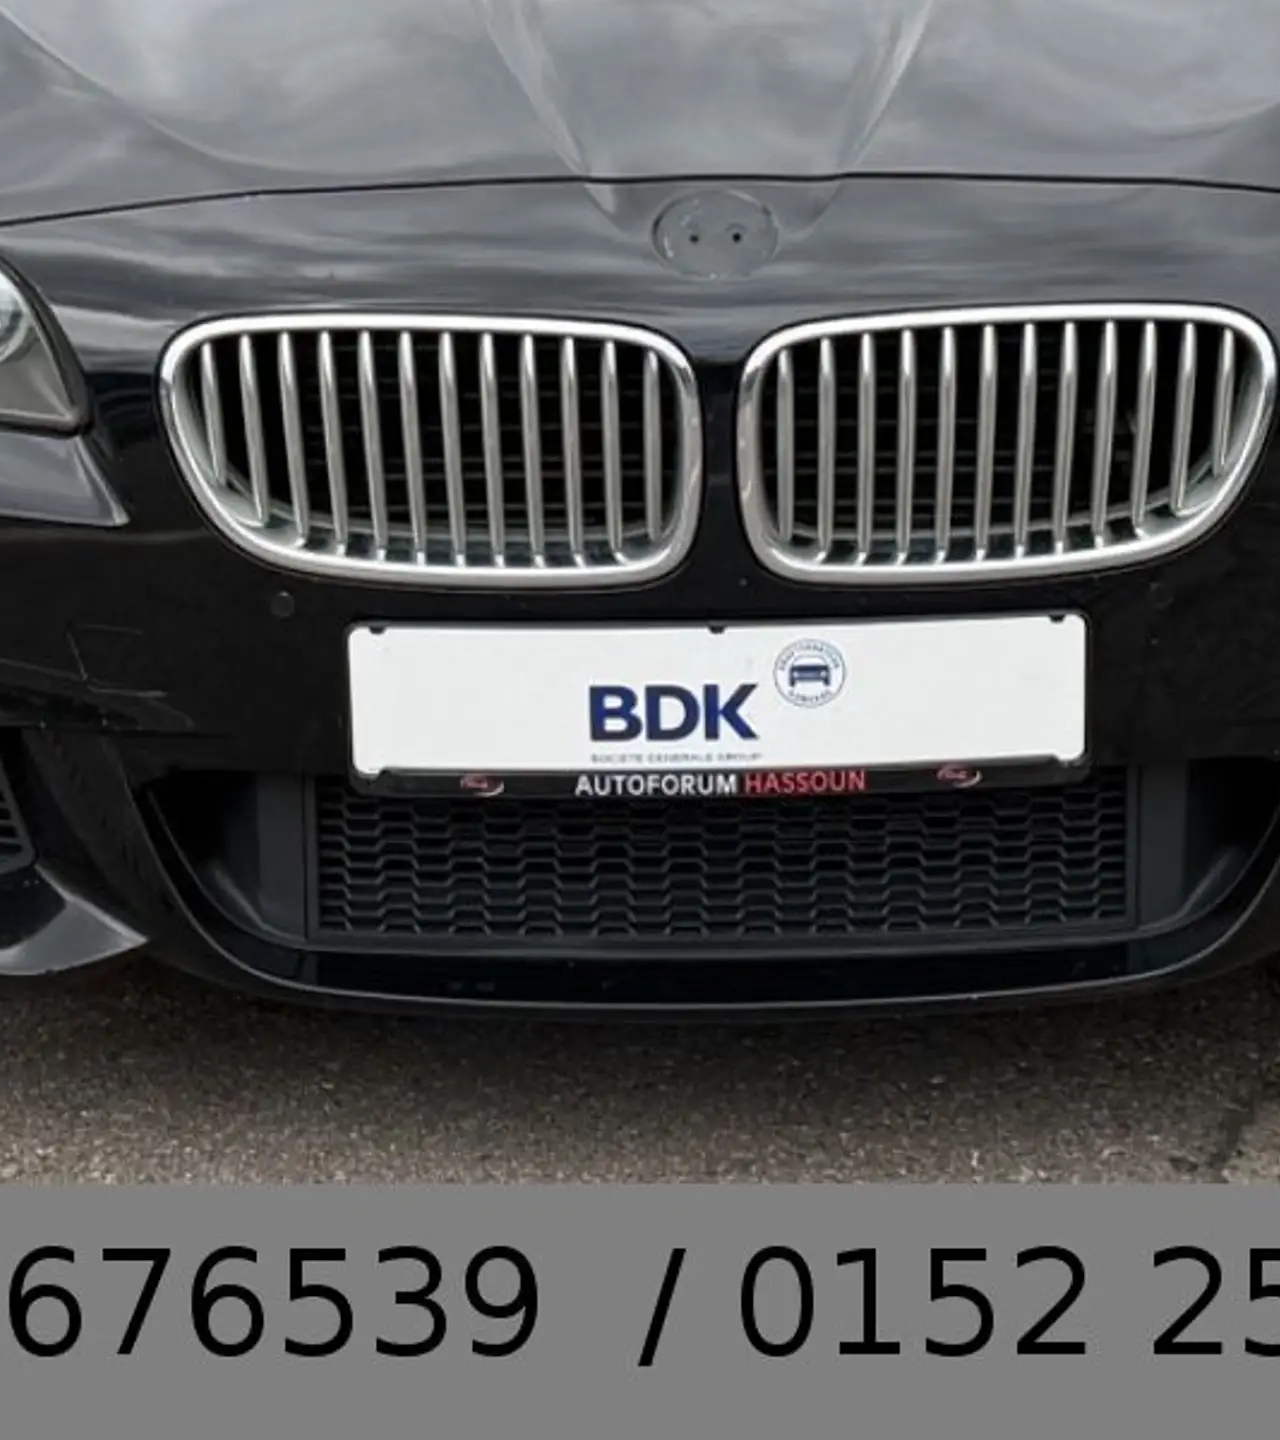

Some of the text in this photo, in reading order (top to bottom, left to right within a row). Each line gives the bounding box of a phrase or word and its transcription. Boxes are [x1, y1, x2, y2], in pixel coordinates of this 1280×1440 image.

[588, 683, 760, 742] BDK
[575, 769, 867, 797] AUTOFORUM HASSOUN
